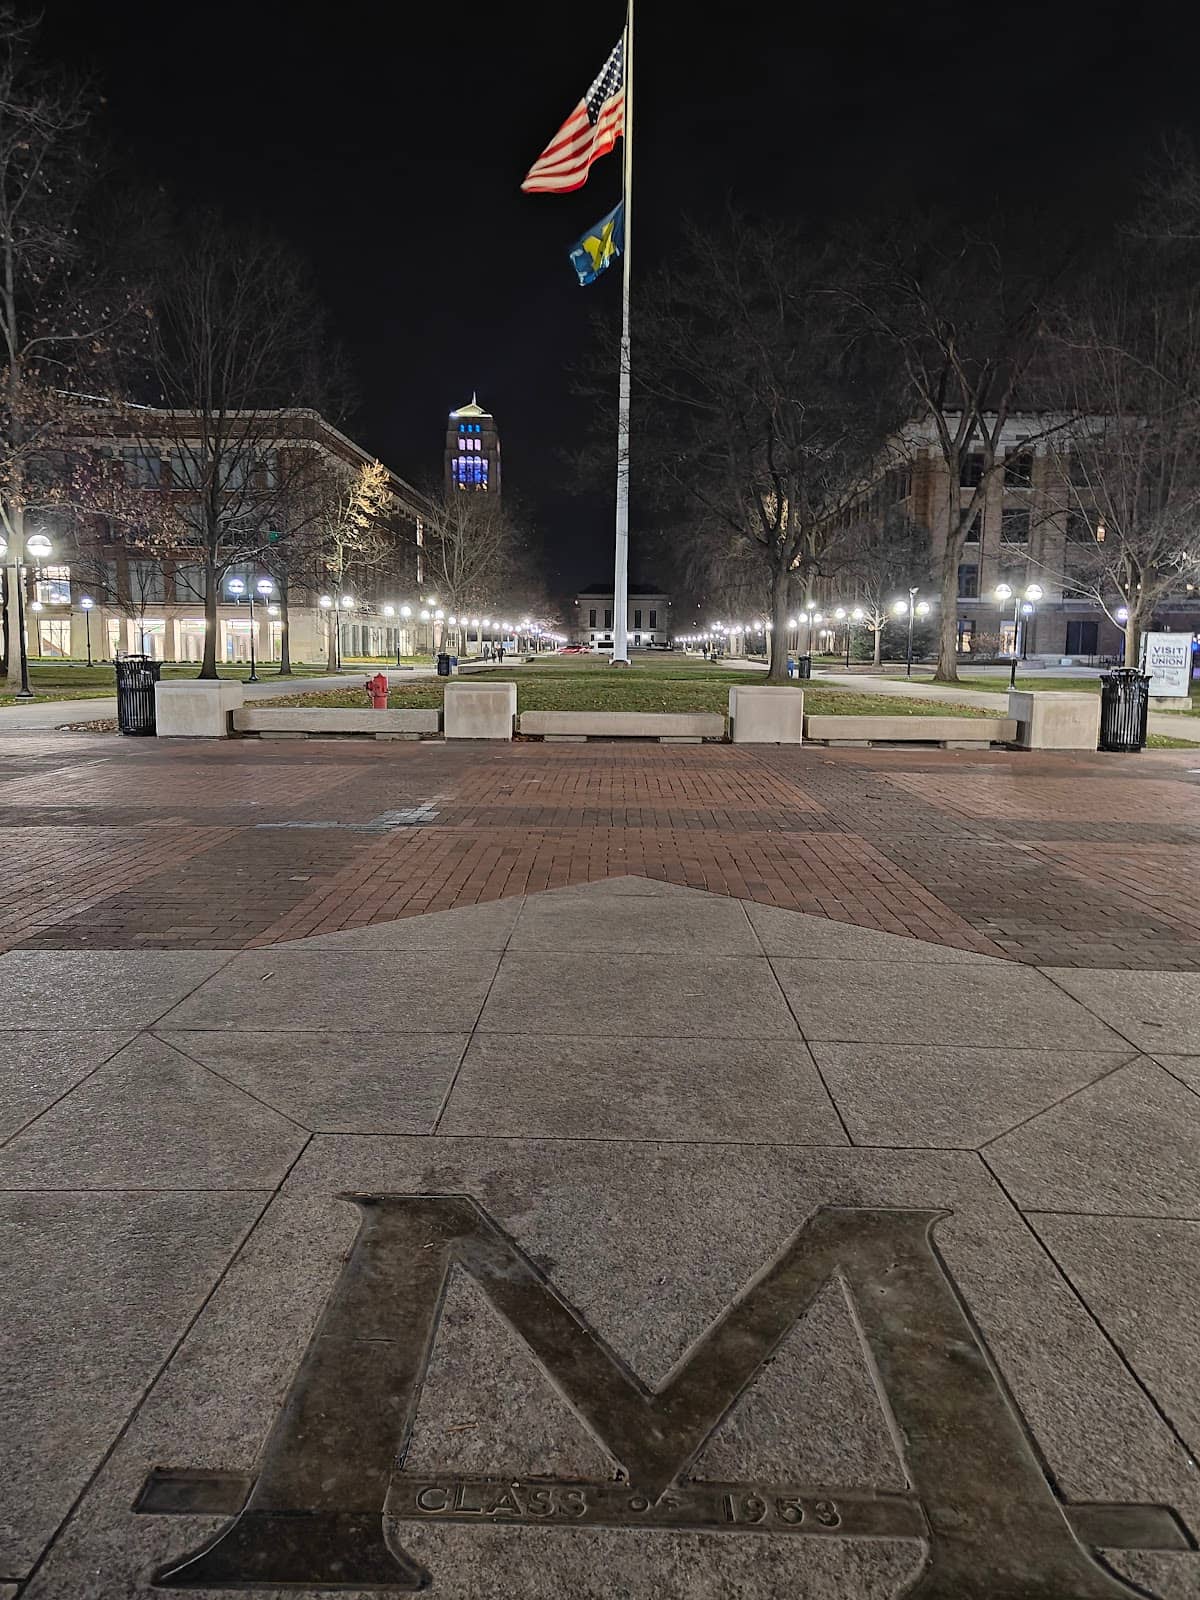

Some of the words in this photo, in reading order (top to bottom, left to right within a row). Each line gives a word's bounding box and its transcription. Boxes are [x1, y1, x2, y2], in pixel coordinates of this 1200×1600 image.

[1153, 646, 1184, 655] VISIT
[1151, 657, 1184, 666] UNION
[416, 1484, 588, 1518] CLASS
[723, 1493, 842, 1530] 1953
